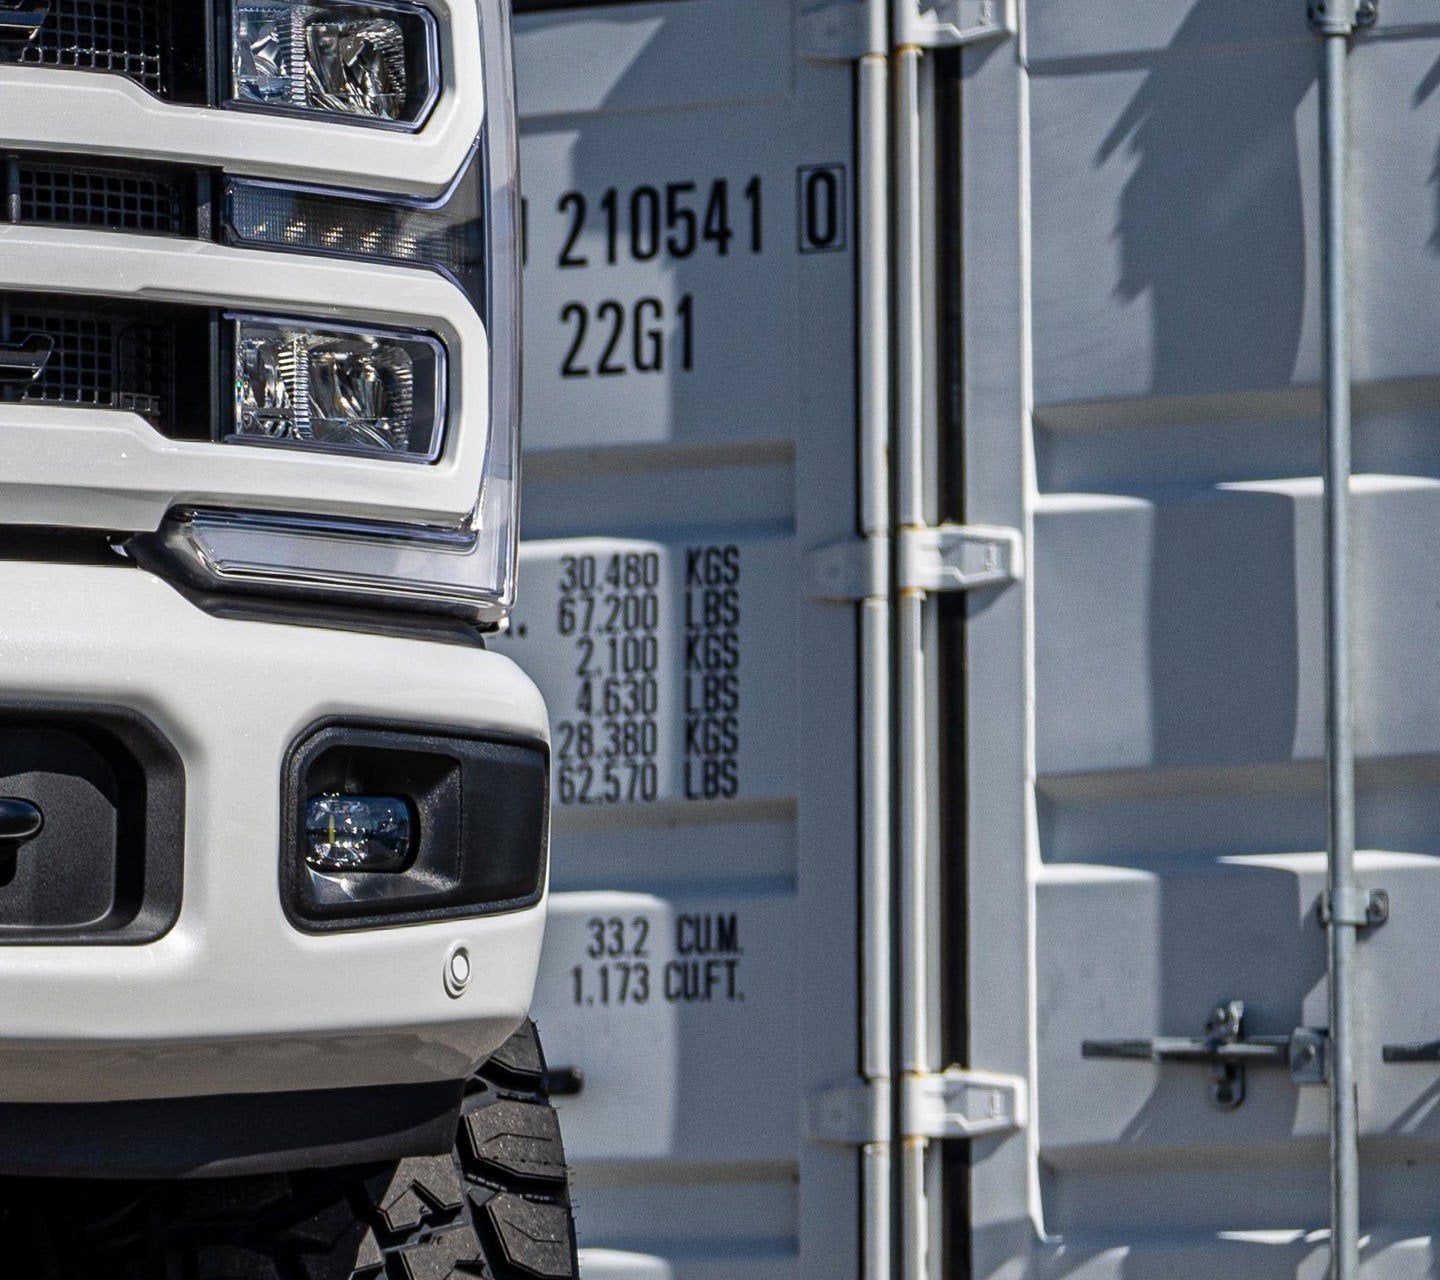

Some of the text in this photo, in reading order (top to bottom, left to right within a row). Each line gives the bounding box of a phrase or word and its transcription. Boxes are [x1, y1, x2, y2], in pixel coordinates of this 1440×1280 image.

[556, 173, 764, 269] 210541
[805, 166, 839, 249] 0
[559, 293, 695, 380] 22G1
[558, 544, 741, 593] 30.480 KGS
[557, 593, 660, 637] 67.200
[684, 587, 741, 631] LBS
[576, 631, 740, 678] 2.100 KGS
[684, 673, 740, 715] LBS
[557, 715, 740, 761] 28.380 KGS
[557, 758, 740, 805] 62.570 LBS
[586, 914, 651, 960] 33.2
